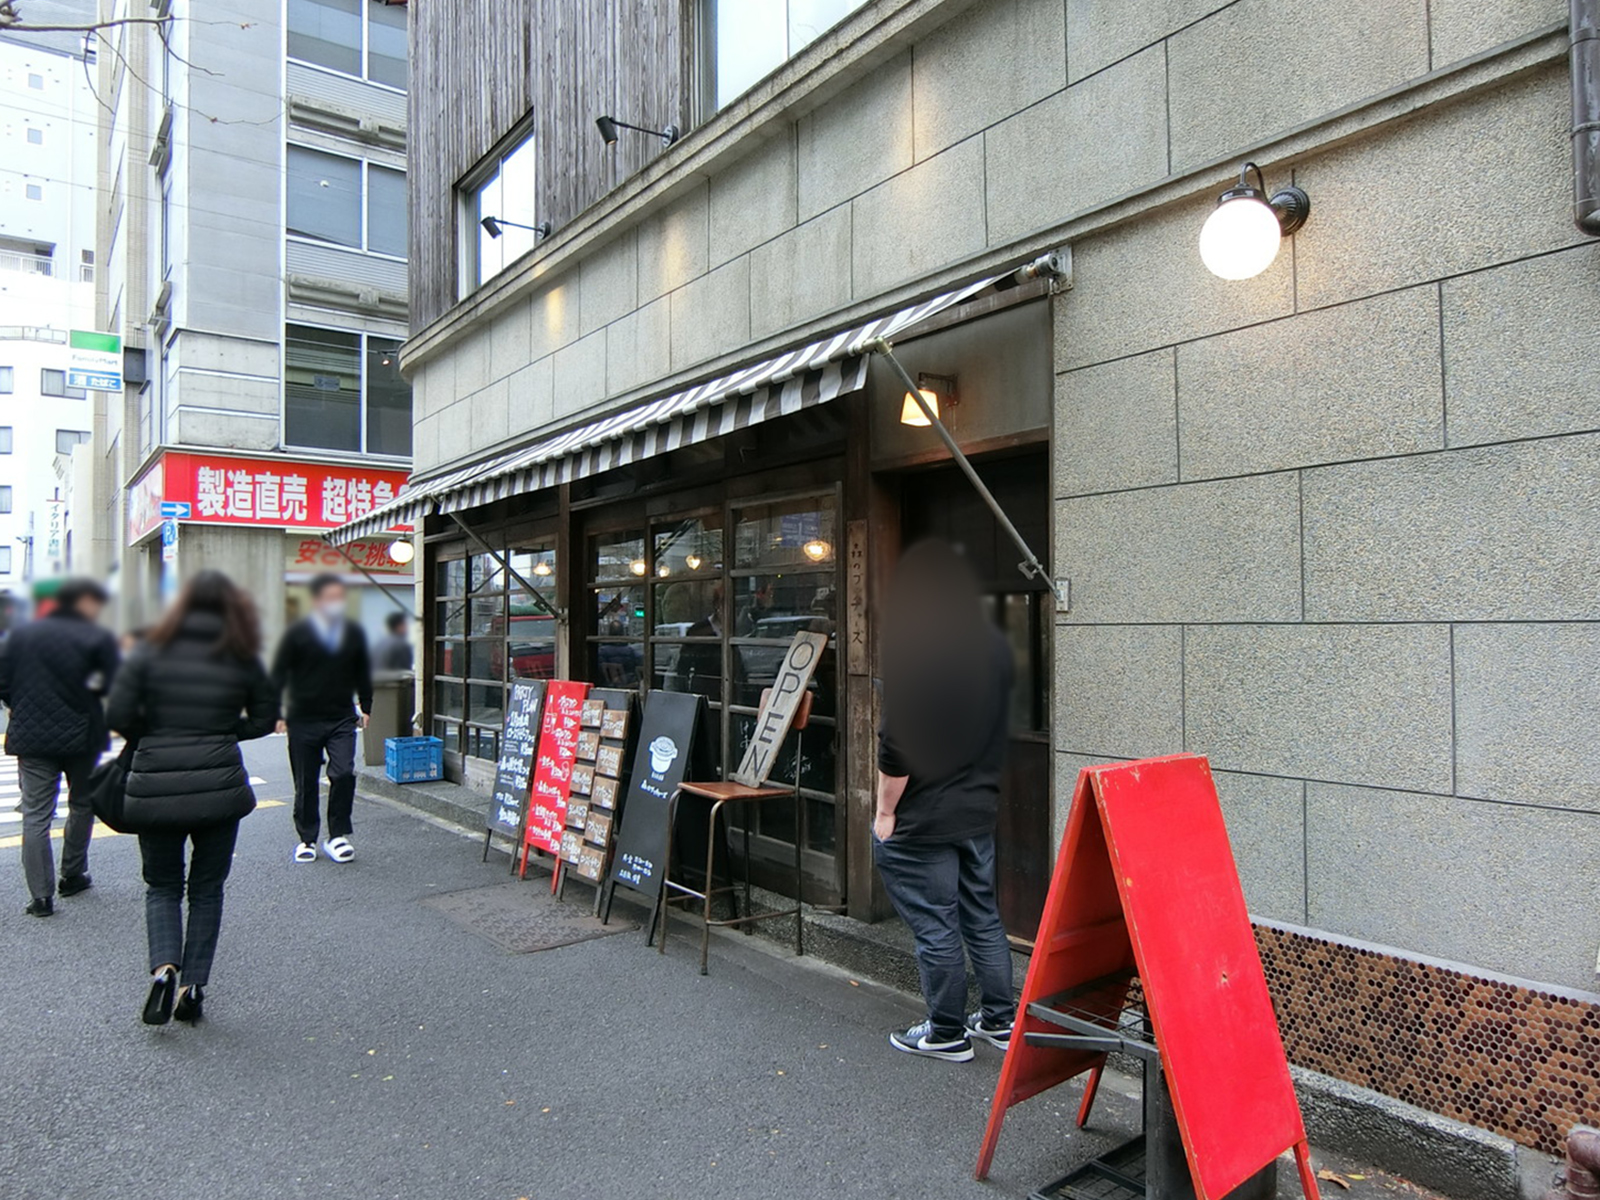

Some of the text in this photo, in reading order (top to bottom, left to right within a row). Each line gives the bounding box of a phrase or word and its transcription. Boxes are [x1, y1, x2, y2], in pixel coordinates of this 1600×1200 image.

[197, 466, 408, 522] 製造直売 超特急
[295, 540, 407, 567] 安さに挑
[743, 641, 815, 779] OPEN
